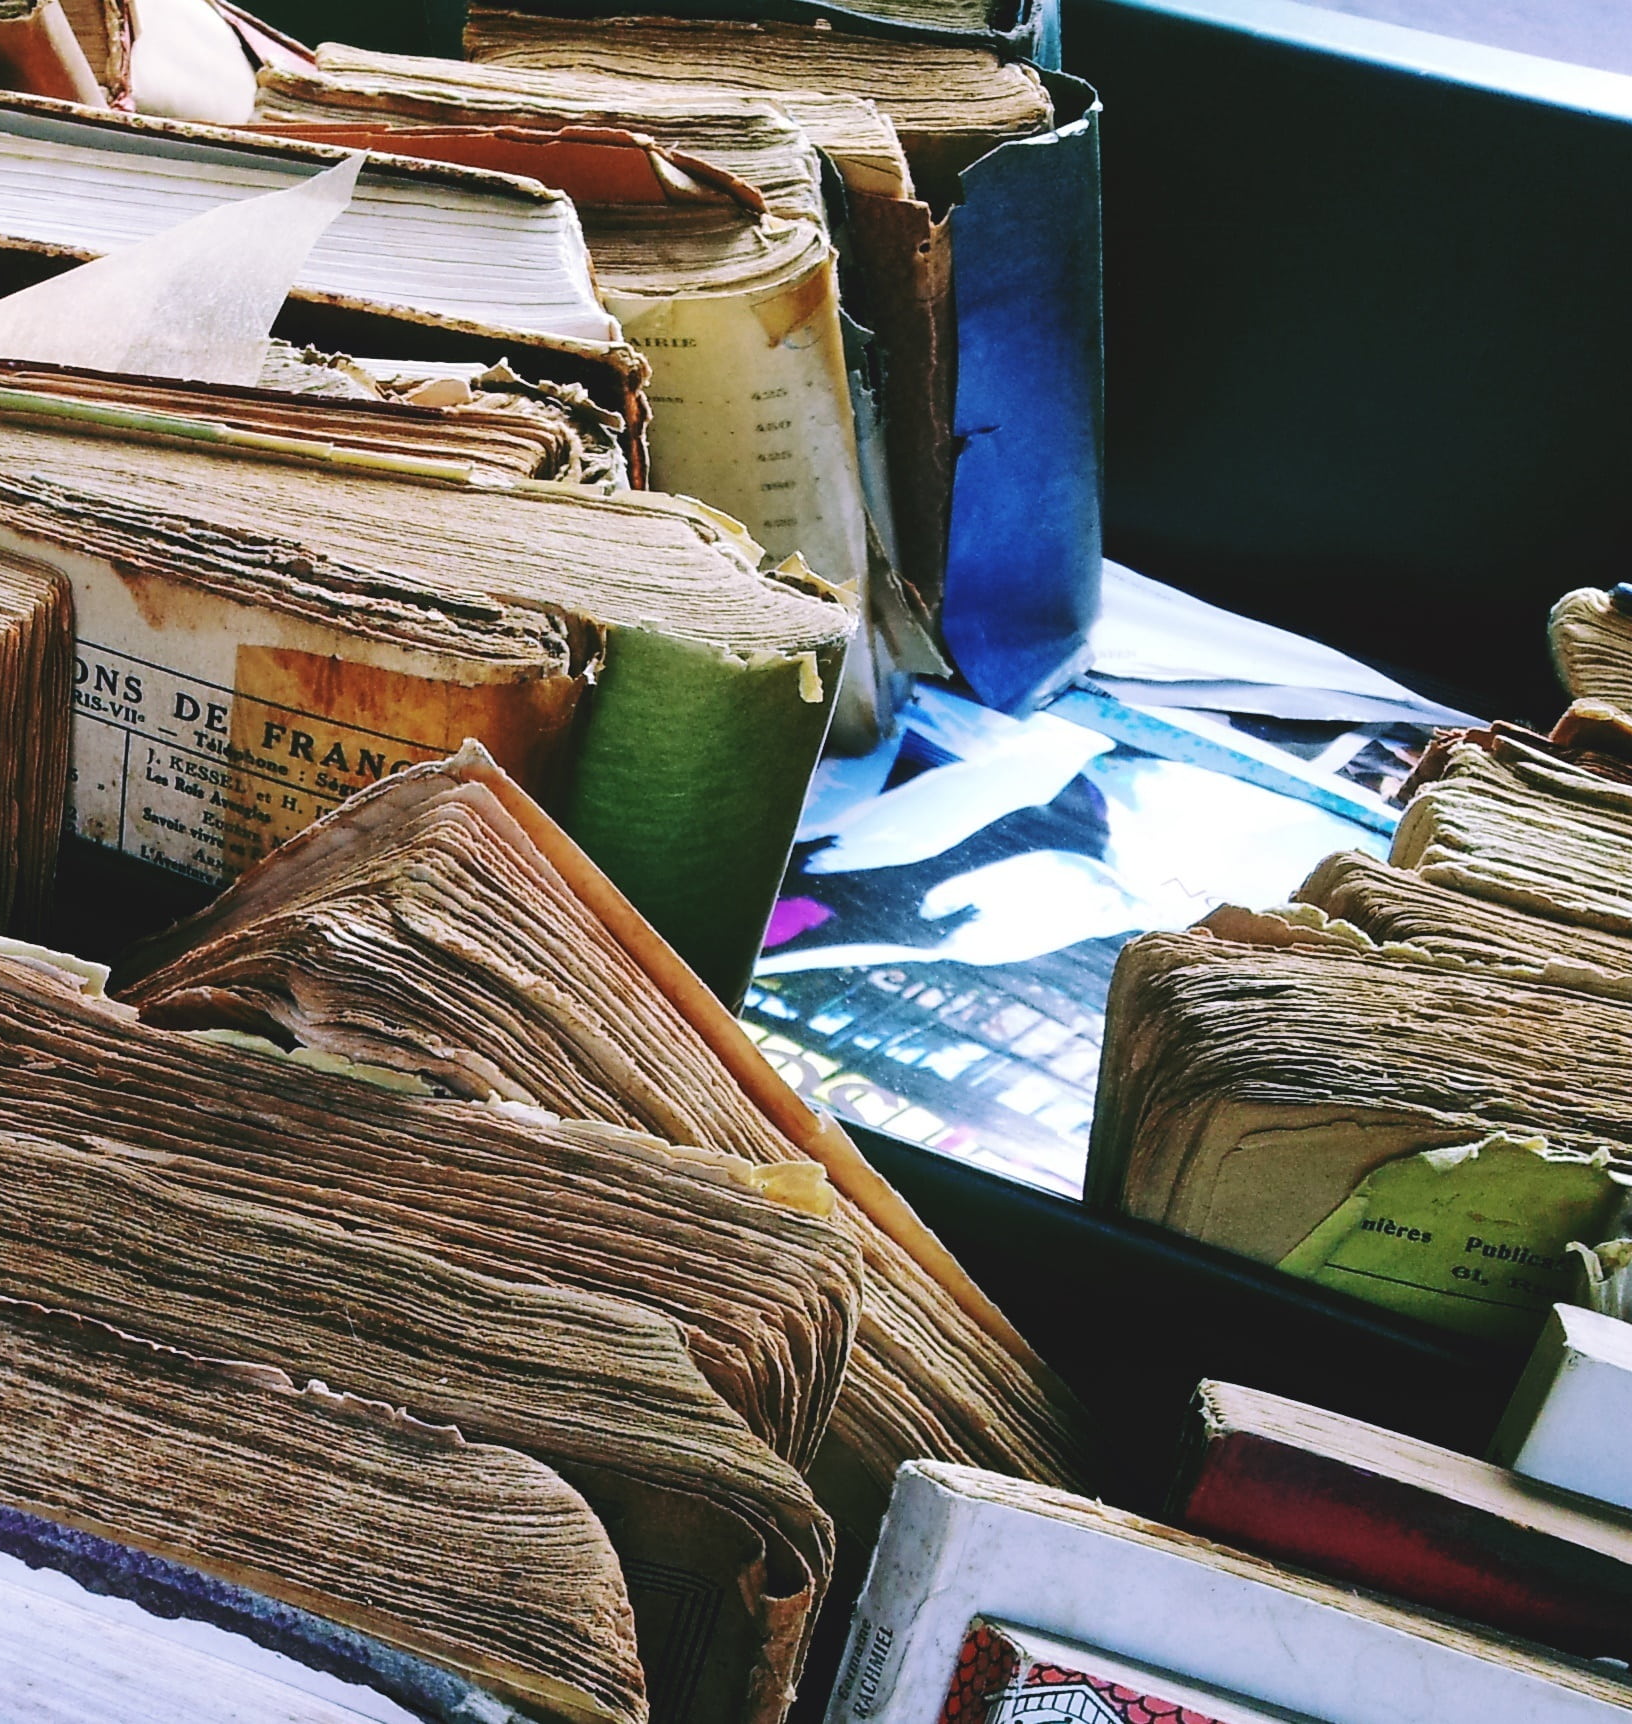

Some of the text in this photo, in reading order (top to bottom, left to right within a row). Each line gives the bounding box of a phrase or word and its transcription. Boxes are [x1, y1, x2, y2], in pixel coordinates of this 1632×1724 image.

[173, 691, 228, 735] DE
[145, 766, 169, 787] Les
[174, 776, 205, 800] Rois
[169, 755, 247, 794] KESSEL
[282, 794, 303, 814] H.
[142, 806, 188, 836] Savoir
[853, 1624, 894, 1720] RACHMIEL
